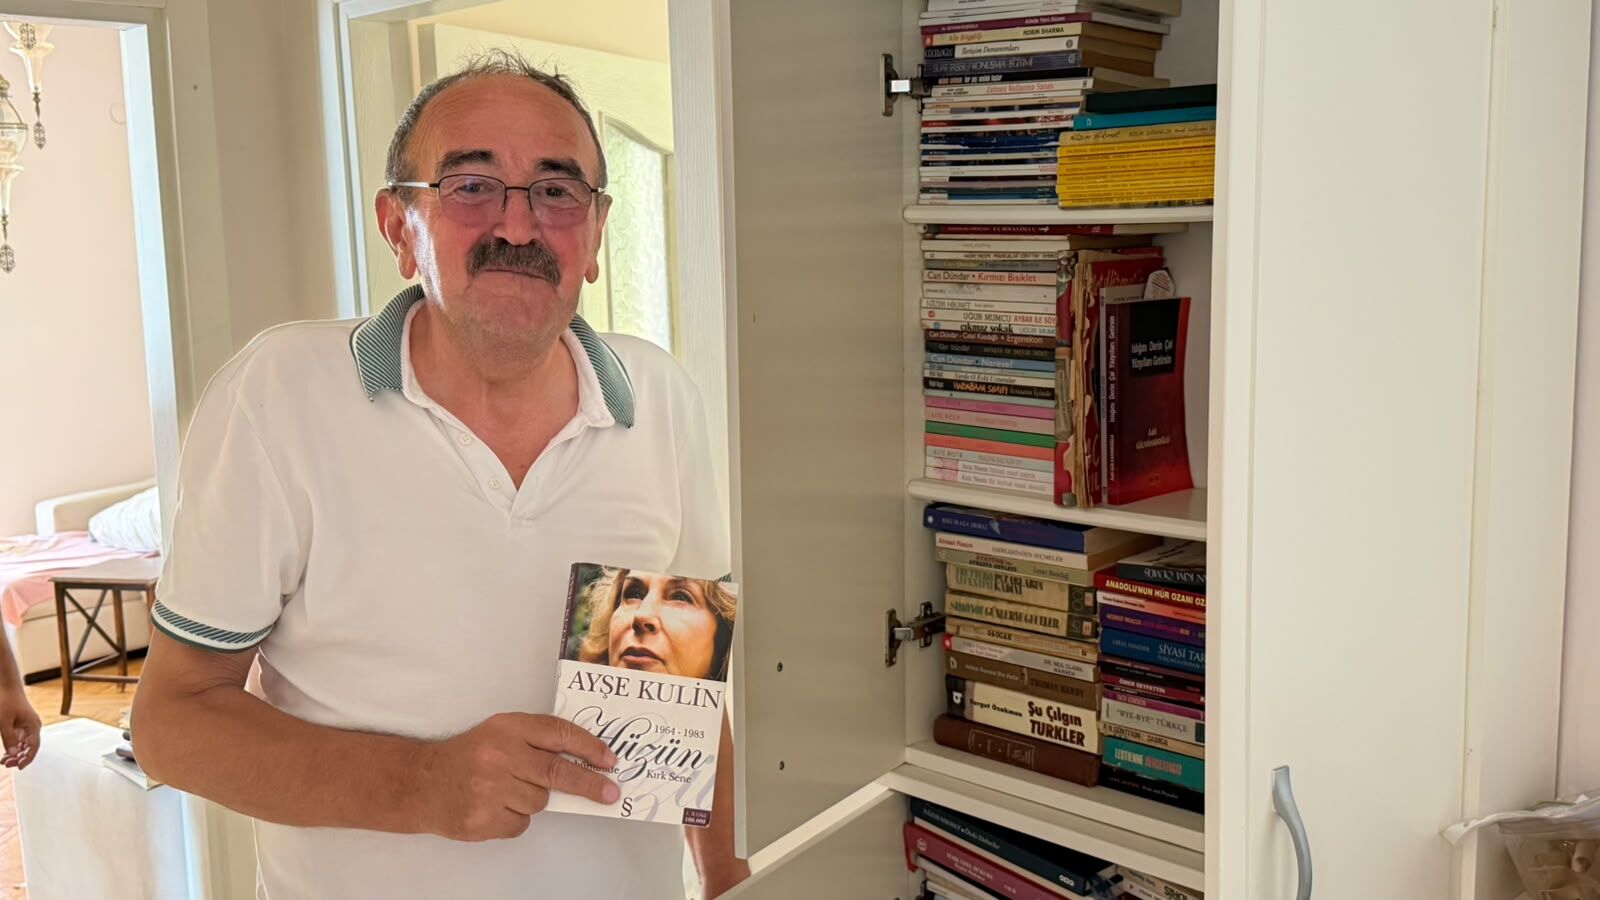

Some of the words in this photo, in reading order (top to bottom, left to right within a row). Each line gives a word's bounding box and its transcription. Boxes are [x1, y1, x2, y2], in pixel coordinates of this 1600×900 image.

[1041, 27, 1064, 35] SHARMA
[926, 271, 942, 280] Can
[942, 271, 970, 280] Dündar
[978, 274, 1006, 282] Kırmızı
[1008, 274, 1036, 282] Bisiklet
[963, 312, 982, 321] UĞUR
[984, 314, 1011, 322] MUMCU
[960, 322, 988, 333] çıkmaz
[990, 322, 1014, 334] sokak
[1006, 334, 1043, 344] Ergenekon
[1148, 340, 1162, 352] Derin
[1164, 338, 1174, 352] Çal
[988, 384, 1008, 394] SINIFI
[938, 538, 956, 546] Ahmet
[956, 540, 974, 549] Rasim
[1105, 579, 1153, 596] ANADOLU'NUN
[1154, 588, 1170, 600] HÜR
[1171, 592, 1194, 604] OZANI
[1158, 643, 1186, 659] SİYASİ
[567, 670, 630, 700] AYŞE
[636, 682, 722, 710] KULİN
[1060, 684, 1084, 698] HARDY
[969, 699, 990, 710] Turgut
[1027, 701, 1042, 718] Şu
[1046, 703, 1082, 728] Çılgın
[654, 724, 676, 736] 1964
[684, 728, 705, 740] 1983
[1156, 718, 1188, 733] TÜRKÇE
[572, 706, 714, 783] Hüzün
[646, 769, 667, 780] Kırk
[670, 772, 693, 784] Sene
